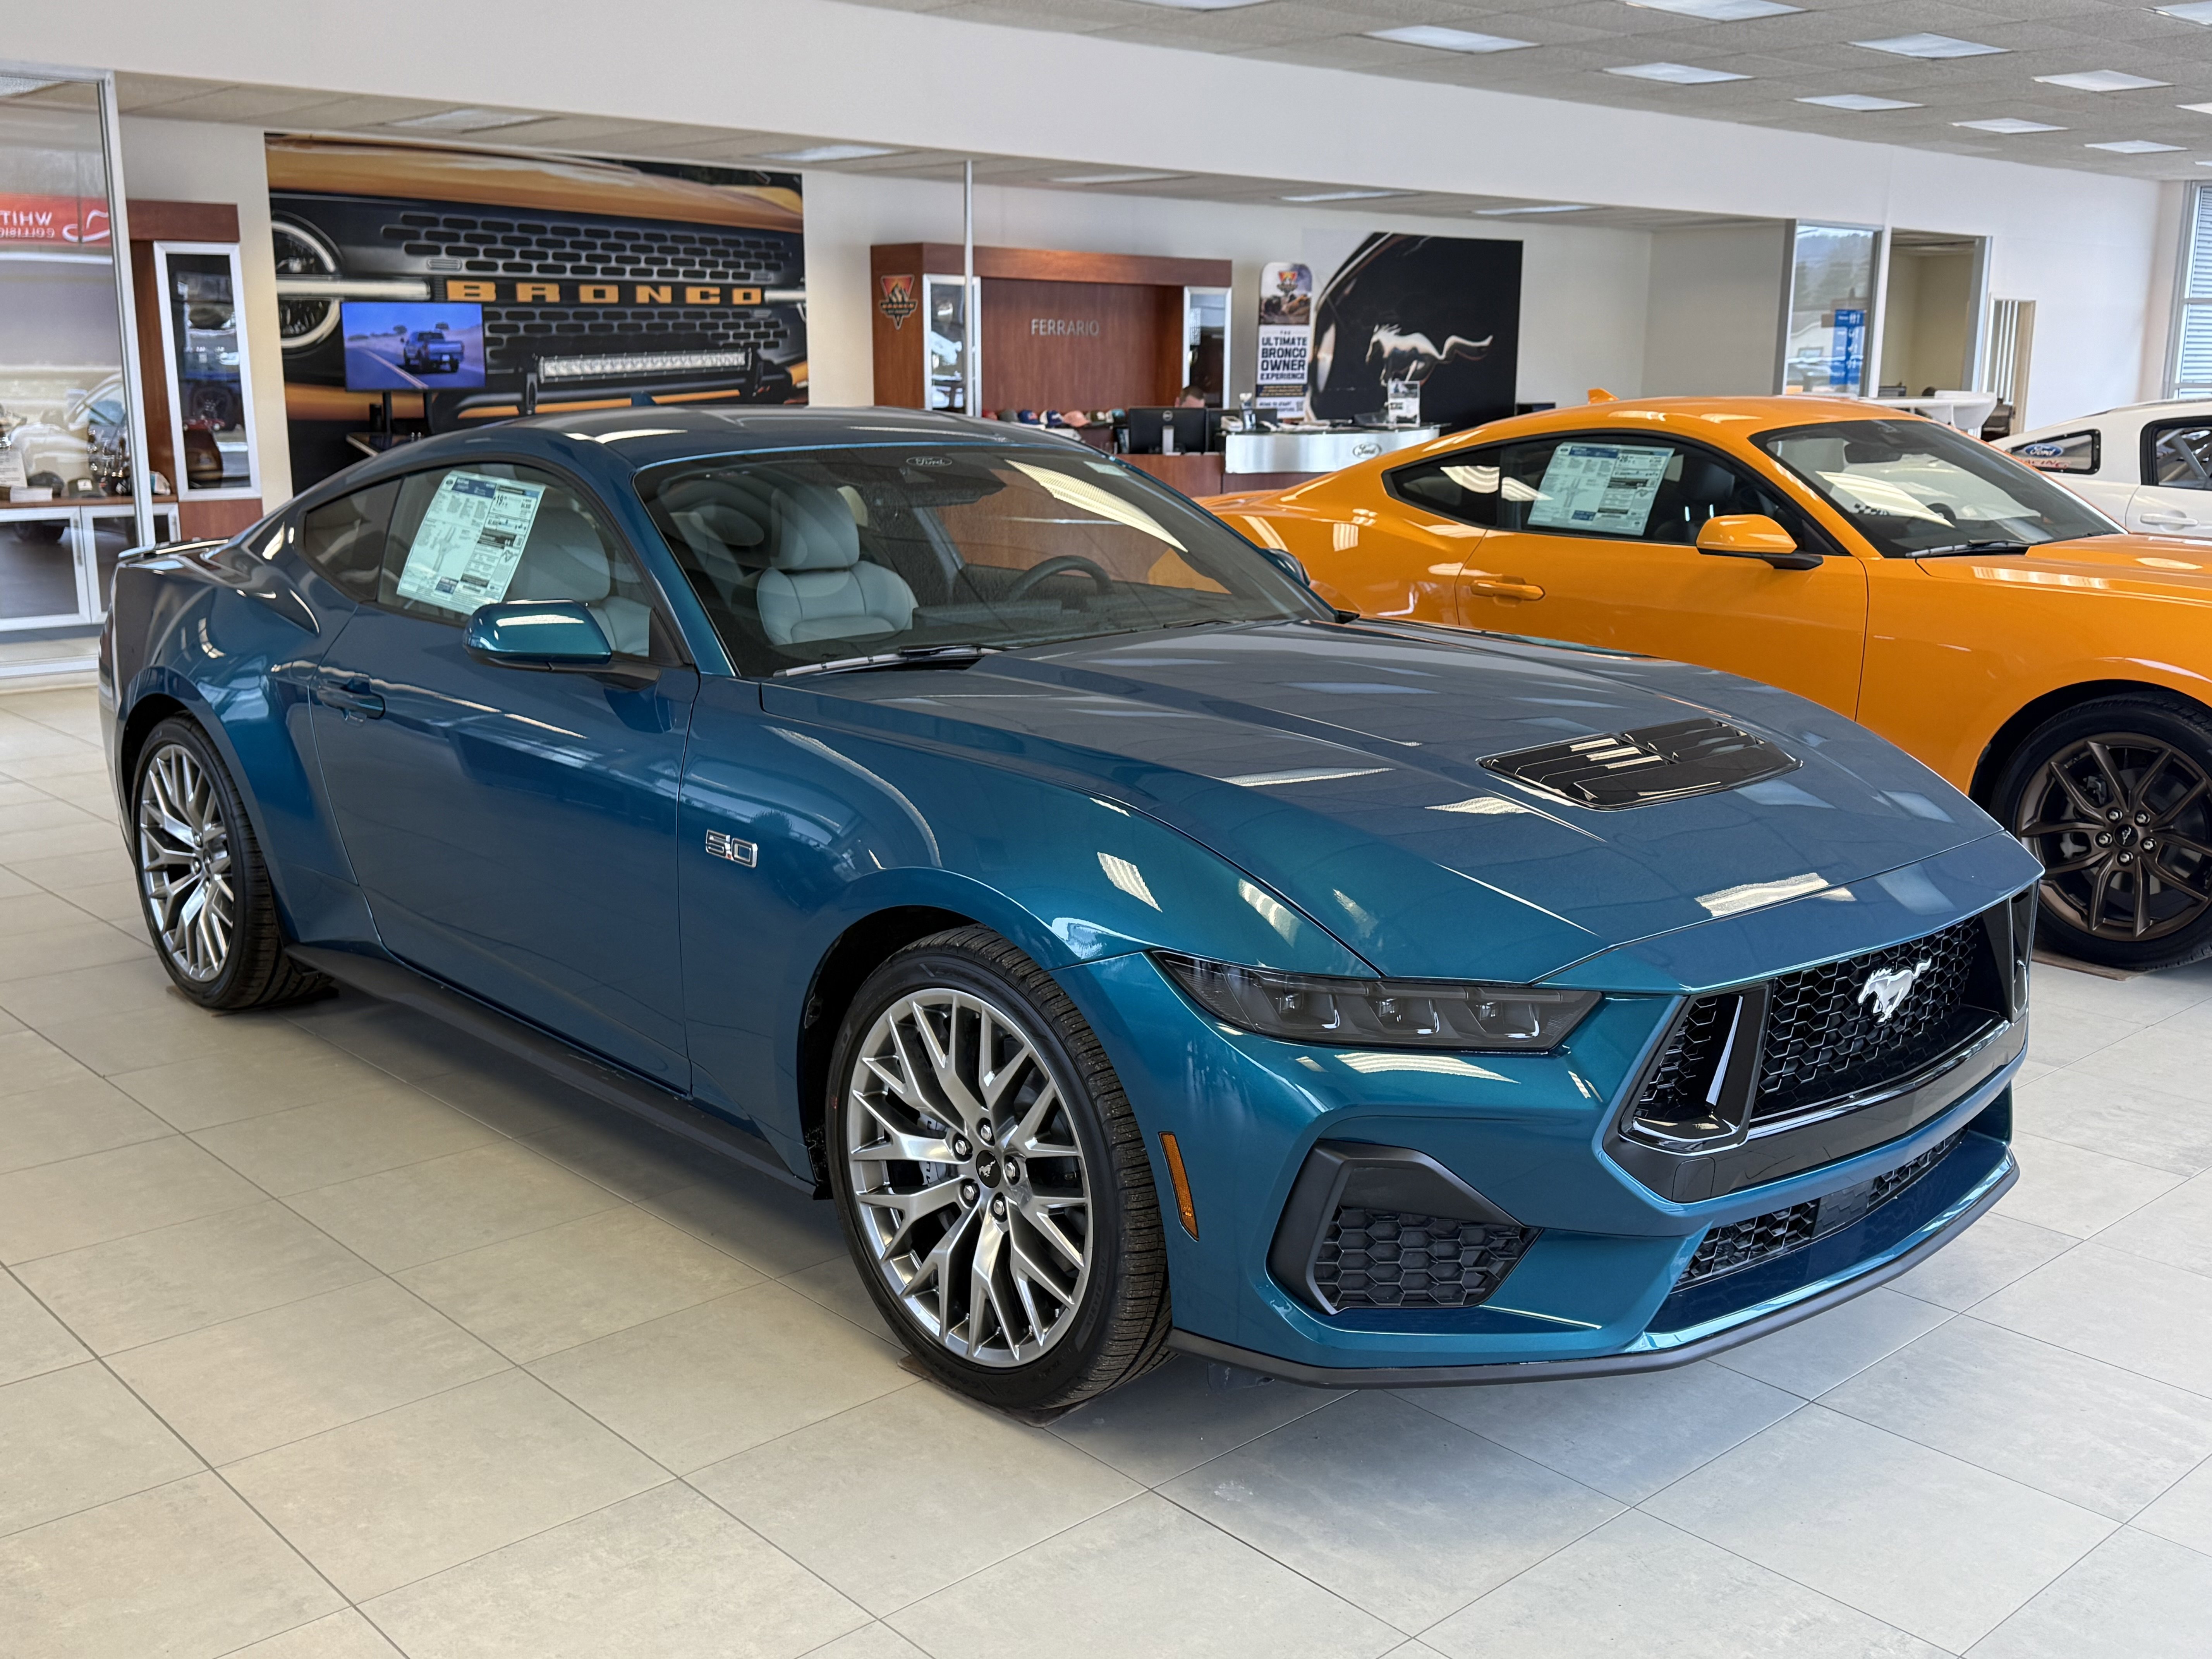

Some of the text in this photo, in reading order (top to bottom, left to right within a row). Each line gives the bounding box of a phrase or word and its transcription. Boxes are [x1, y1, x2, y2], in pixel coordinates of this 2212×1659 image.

[446, 280, 761, 305] BRONCO
[1031, 319, 1099, 336] FERRARIO
[1262, 337, 1307, 346] ULTIMATE
[1261, 347, 1307, 358] BRONCO
[1261, 359, 1305, 371] OWNER
[2030, 445, 2056, 456] Ford
[915, 457, 945, 466] Ford
[2024, 459, 2069, 469] ACING
